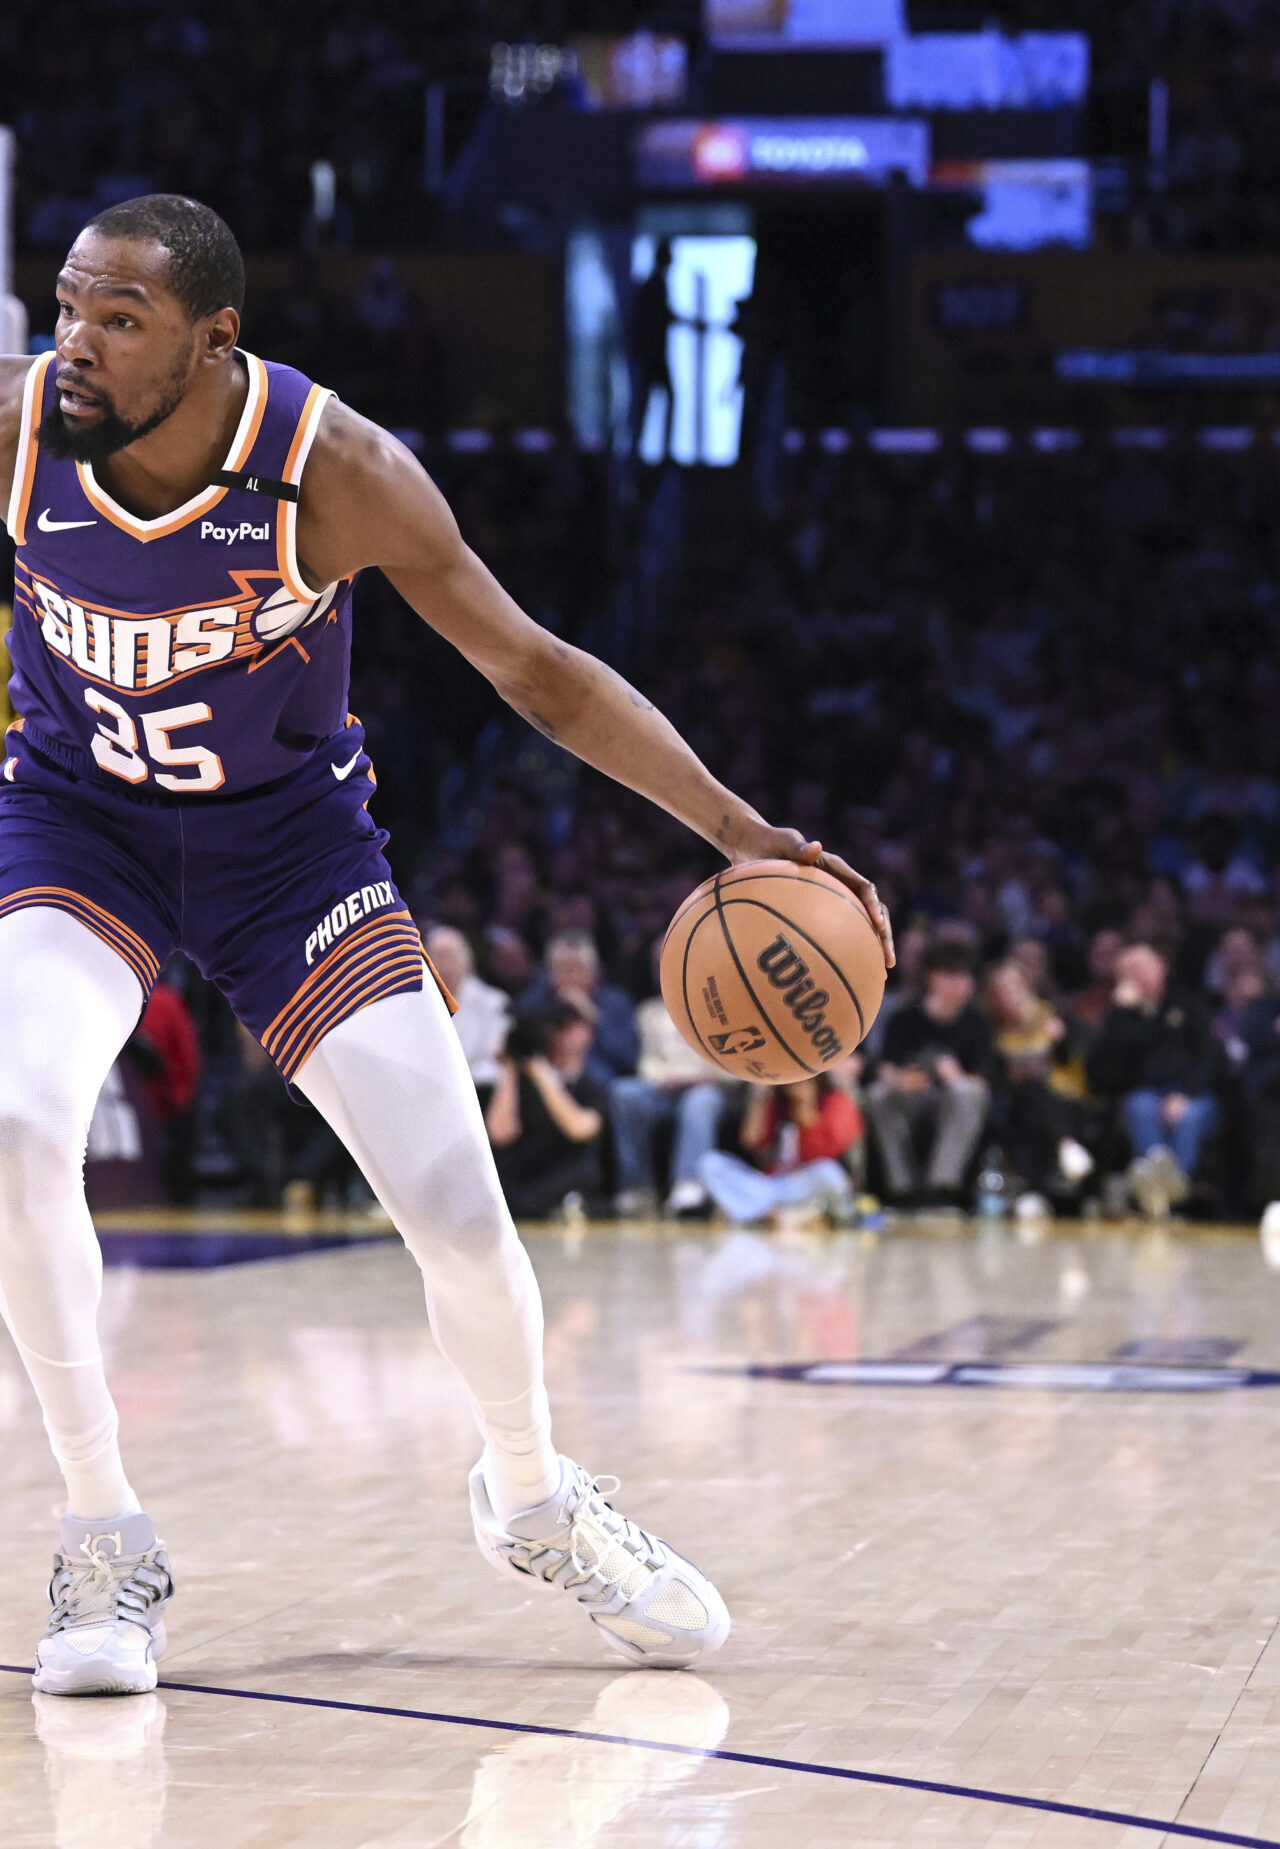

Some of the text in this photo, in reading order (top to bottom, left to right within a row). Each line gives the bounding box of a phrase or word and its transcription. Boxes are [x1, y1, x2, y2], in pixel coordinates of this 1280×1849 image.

[245, 476, 260, 492] AL
[201, 521, 270, 546] PayPal
[34, 580, 239, 689] SUNS
[83, 686, 226, 792] 35
[305, 880, 395, 967] PHOENIX
[757, 932, 844, 1064] Wilson
